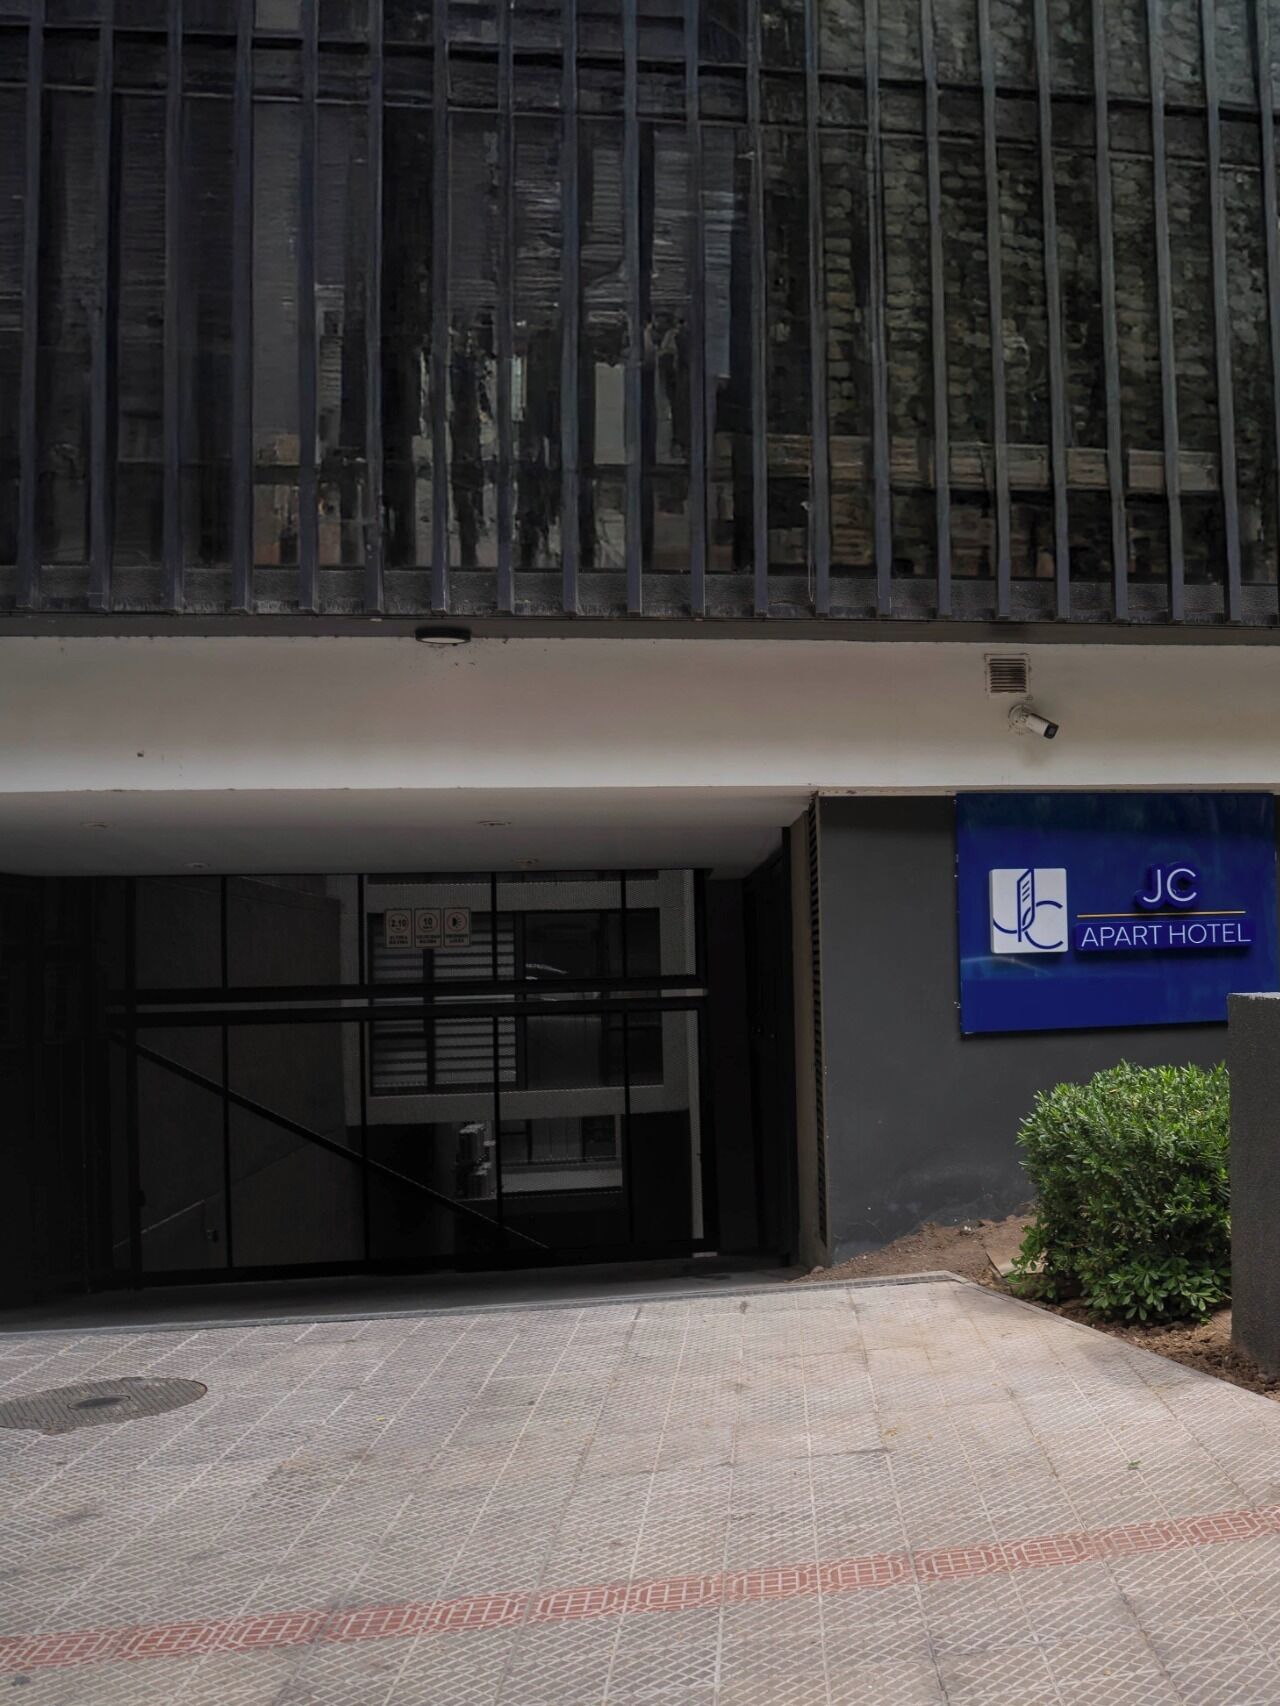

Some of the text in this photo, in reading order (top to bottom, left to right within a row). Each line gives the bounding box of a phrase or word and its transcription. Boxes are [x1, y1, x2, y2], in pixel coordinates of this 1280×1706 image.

[1143, 868, 1197, 903] JC
[1081, 923, 1252, 947] APART HOTEL
